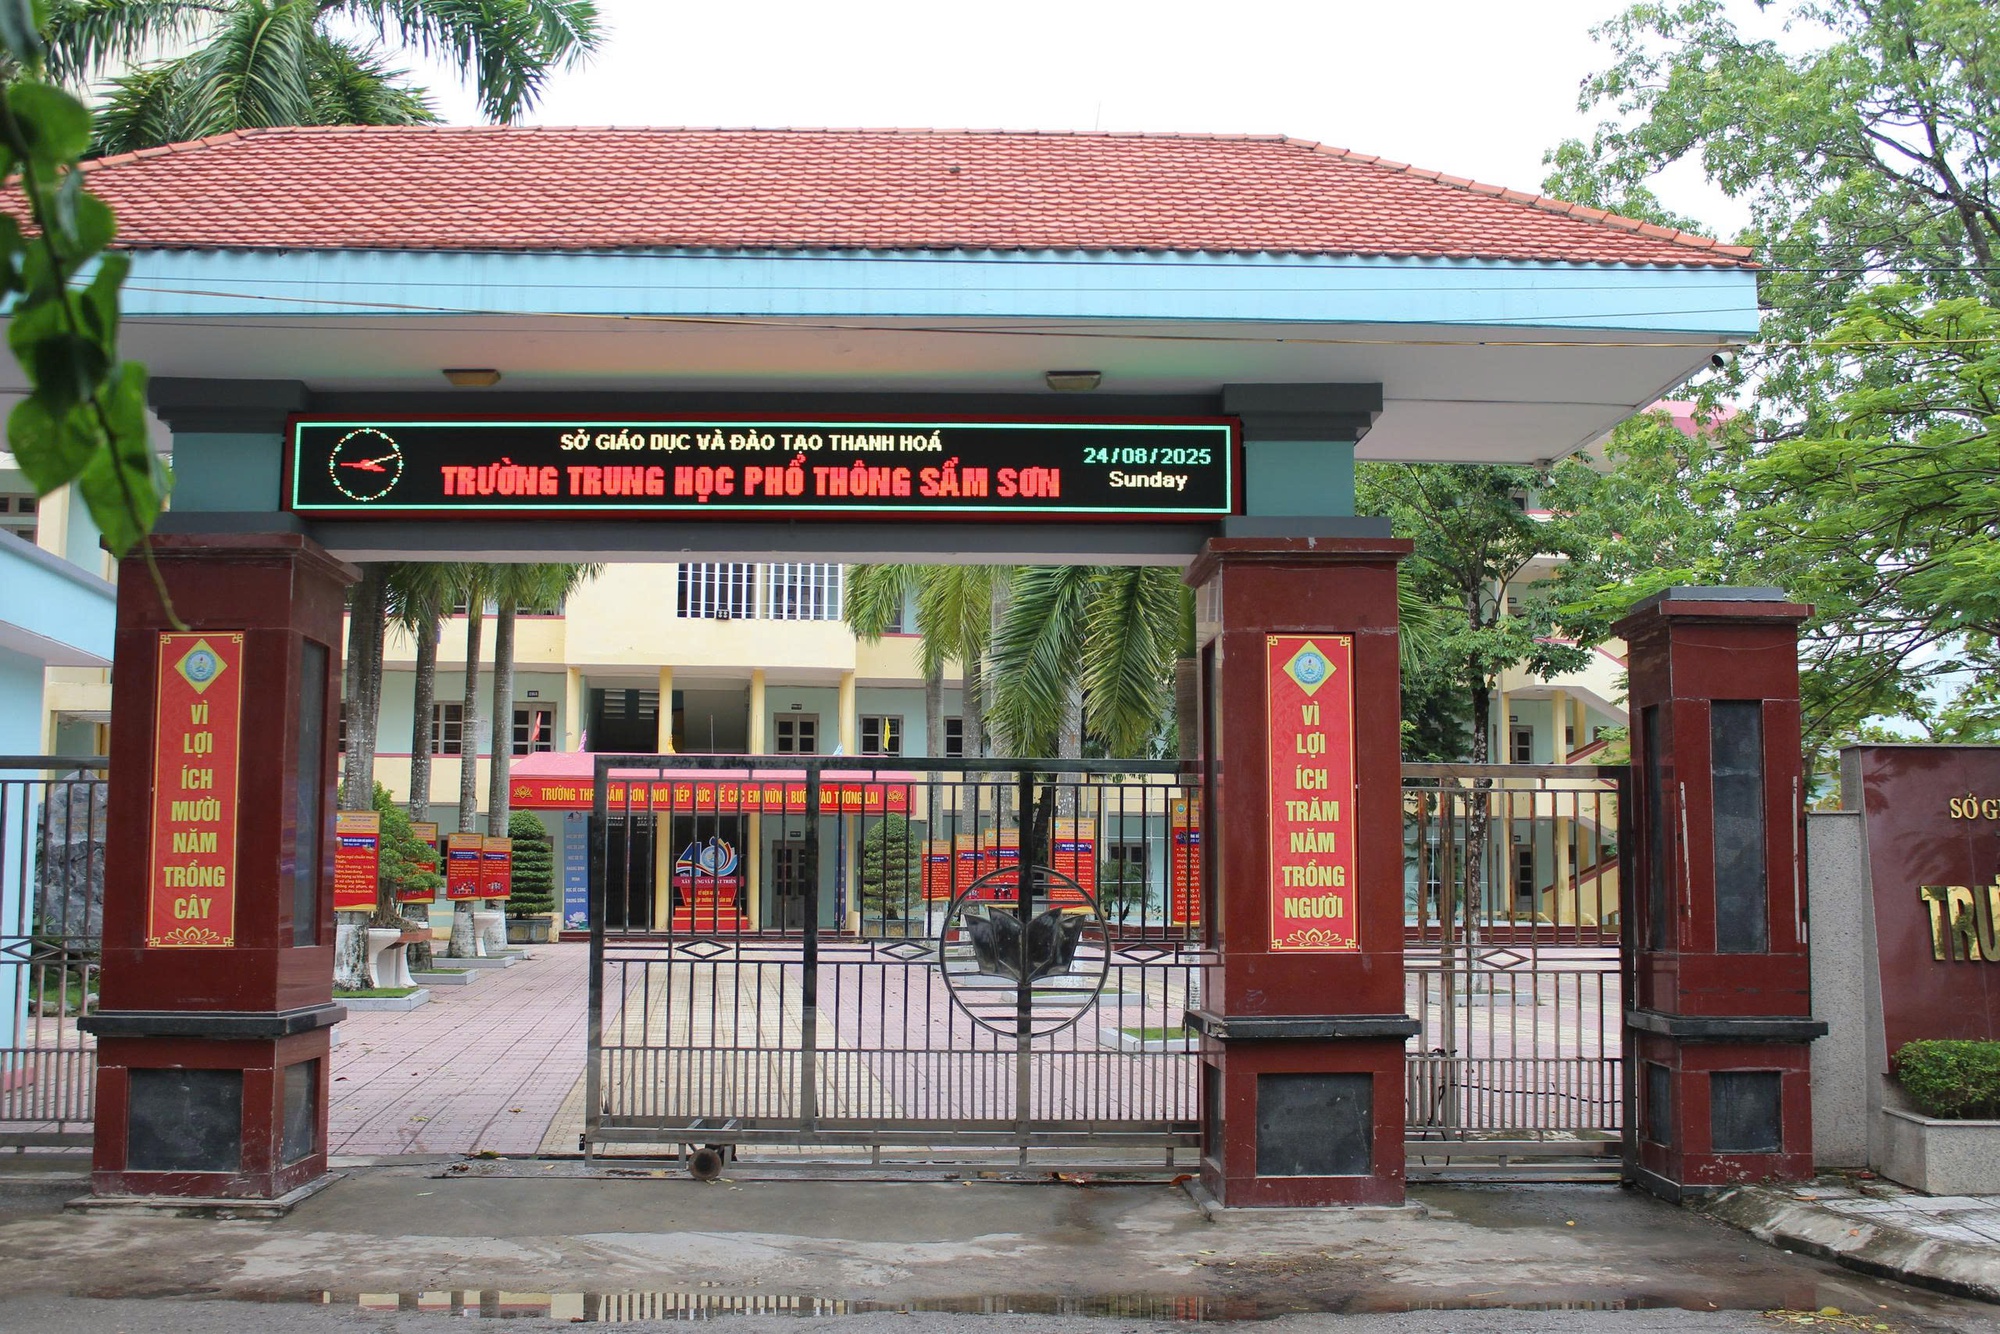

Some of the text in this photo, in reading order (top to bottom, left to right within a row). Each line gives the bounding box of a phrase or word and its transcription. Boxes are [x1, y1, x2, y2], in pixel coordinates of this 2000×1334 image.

[560, 428, 942, 454] SỞ GIÁO DỤC VÀ ĐÀO TẠO THANH HOÁ
[1083, 447, 1212, 465] 24/08/2025
[441, 456, 559, 496] TRƯỜNG
[567, 466, 665, 496] TRUNG
[674, 466, 735, 503] HỌC
[744, 453, 807, 497] PHỔ
[813, 459, 911, 497] THÔNG
[997, 466, 1060, 498] SƠN
[1109, 470, 1189, 491] Sunday
[190, 699, 209, 725] VÌ
[1301, 700, 1320, 726] VÌ
[183, 732, 213, 759] LỢI
[1296, 733, 1327, 759] LỢI
[181, 764, 213, 790] ÍCH
[1295, 764, 1328, 790] ÍCH
[541, 784, 576, 802] TRƯỜNG
[865, 791, 879, 805] LAI
[171, 795, 221, 822] MƯỜI
[1285, 796, 1340, 822] TRĂM
[172, 828, 218, 854] NĂM
[1290, 828, 1336, 854] NĂM
[163, 859, 226, 888] TRỒNG
[1282, 858, 1346, 888] TRỒNG
[174, 894, 213, 920] CÂY
[1283, 891, 1344, 919] NGƯỜI
